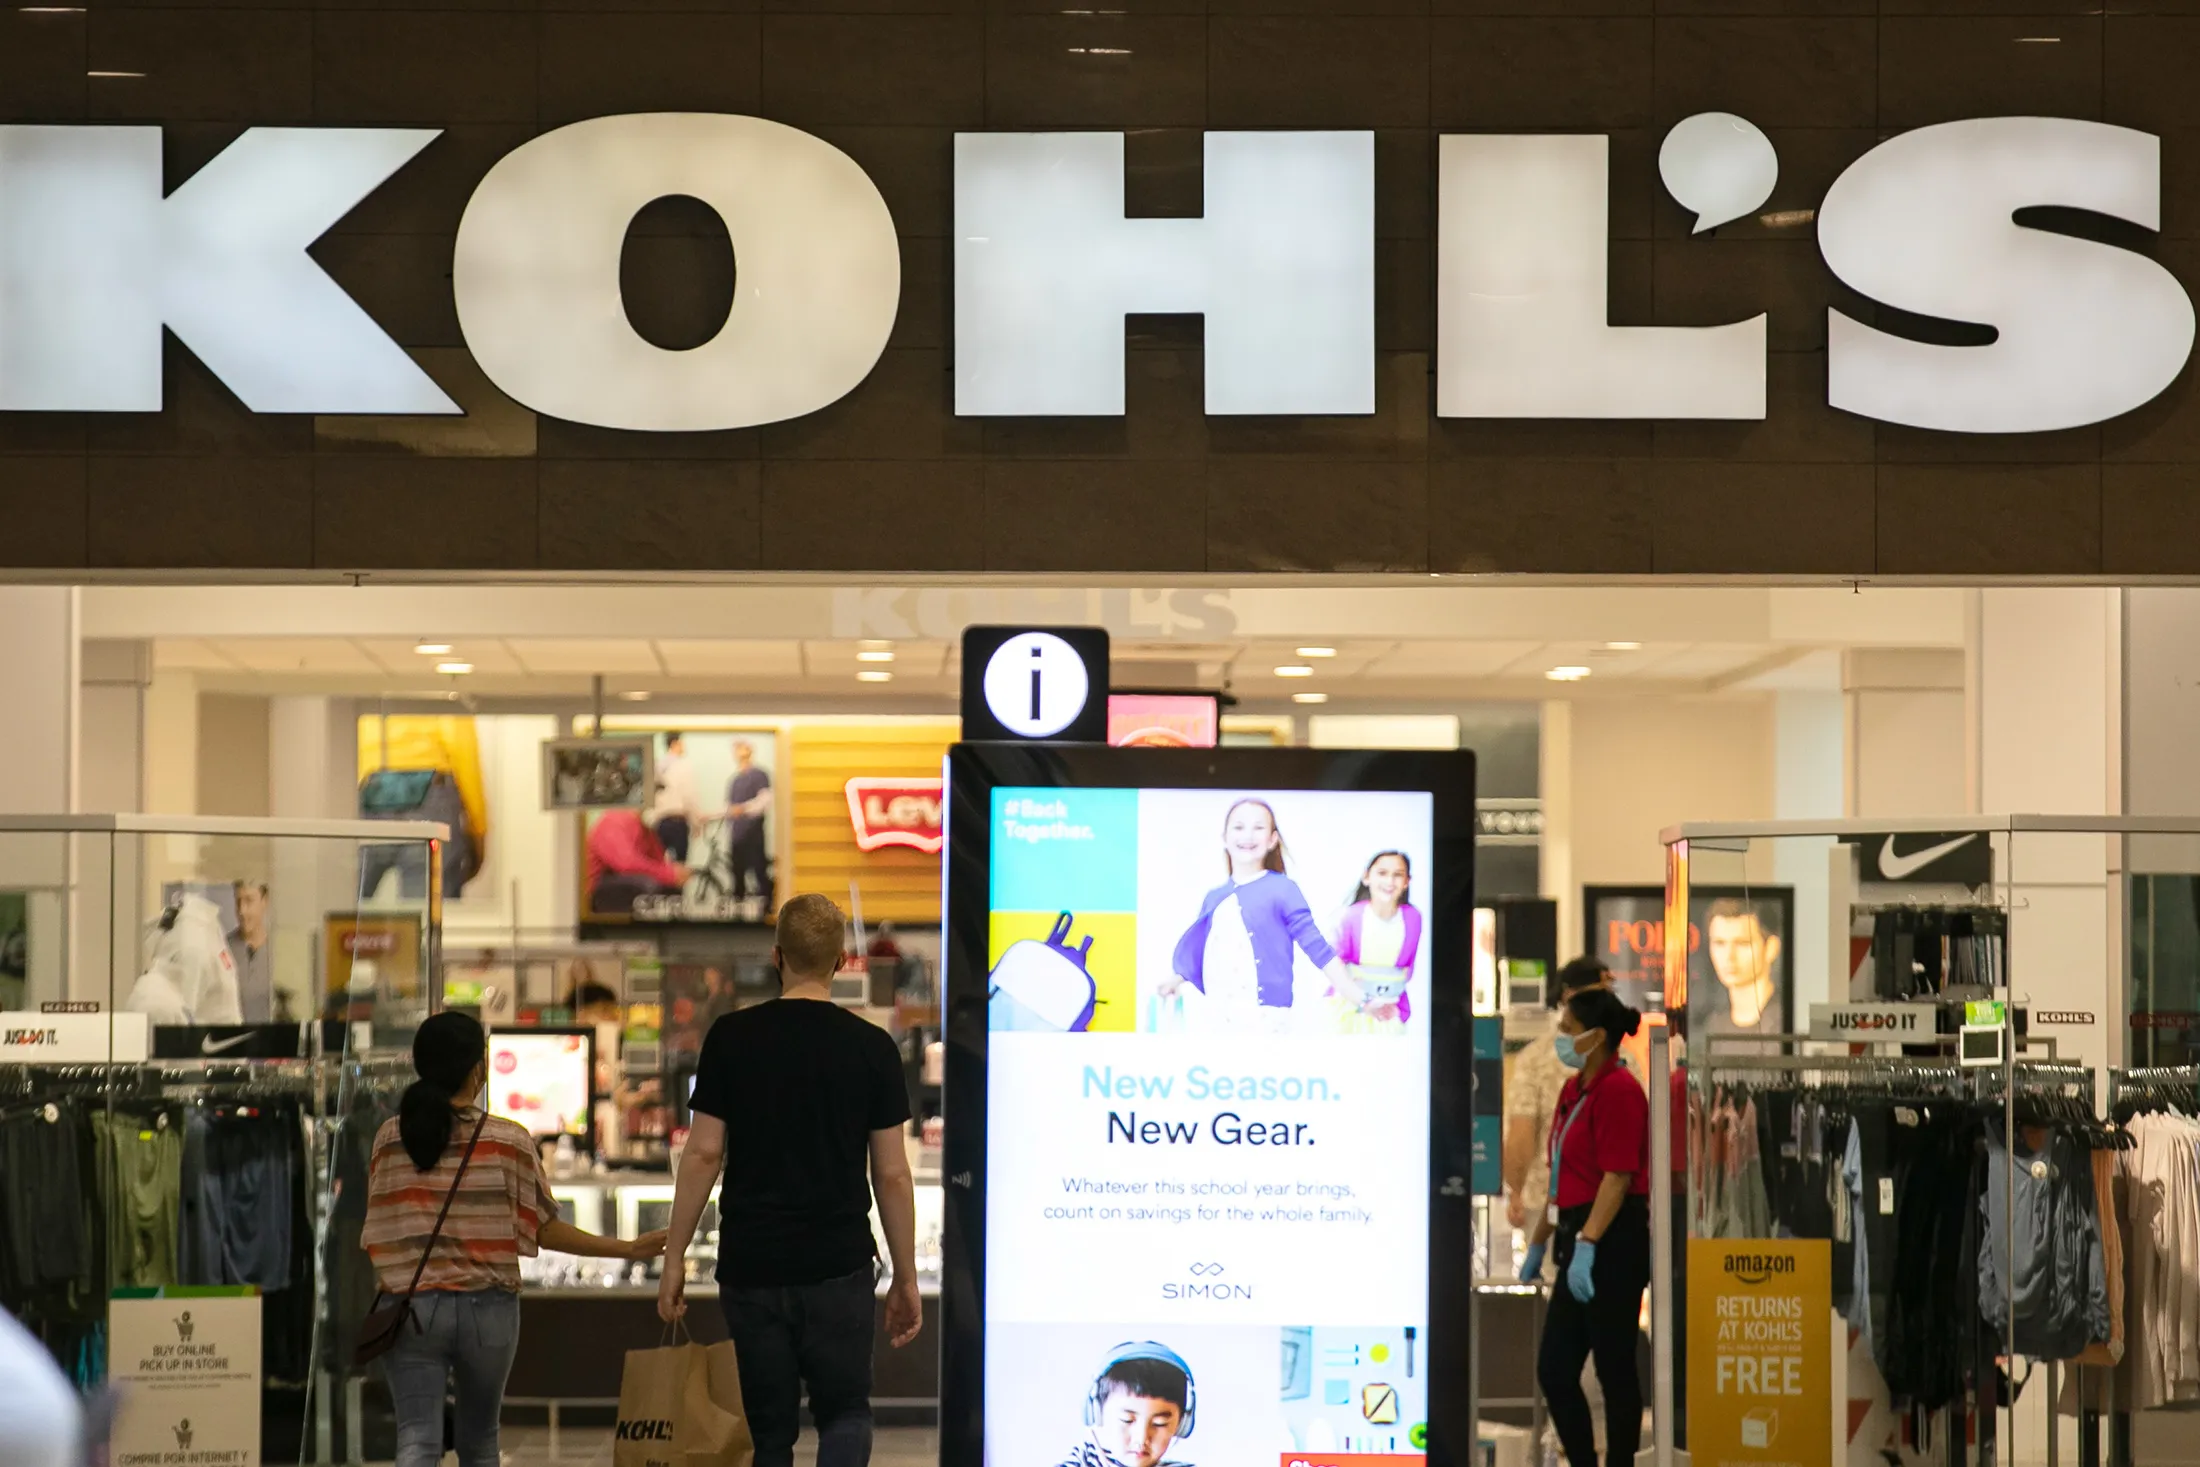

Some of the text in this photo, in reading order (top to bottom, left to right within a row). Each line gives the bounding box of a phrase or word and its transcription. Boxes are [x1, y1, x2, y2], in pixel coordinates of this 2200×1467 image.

[0, 112, 2196, 433] KOHL'S
[1003, 819, 1095, 844] Together.
[1830, 1012, 1868, 1030] JUST
[1873, 1012, 1897, 1030] DO
[2038, 1012, 2093, 1024] KOHL'S
[1082, 1065, 1341, 1101] New Season.
[1107, 1111, 1315, 1146] New Gear.
[1062, 1176, 1356, 1200] Whatever this school year brings,
[1043, 1203, 1373, 1226] count on savings for the whole family.
[1724, 1254, 1795, 1273] amazon
[1162, 1283, 1252, 1300] SIMON
[1716, 1296, 1802, 1319] RETURNS
[1717, 1320, 1802, 1341] AT KOHL'S
[152, 1343, 216, 1357] BUY ONLINE
[139, 1357, 229, 1371] PICK UP IN STORE
[1716, 1355, 1803, 1395] FREE
